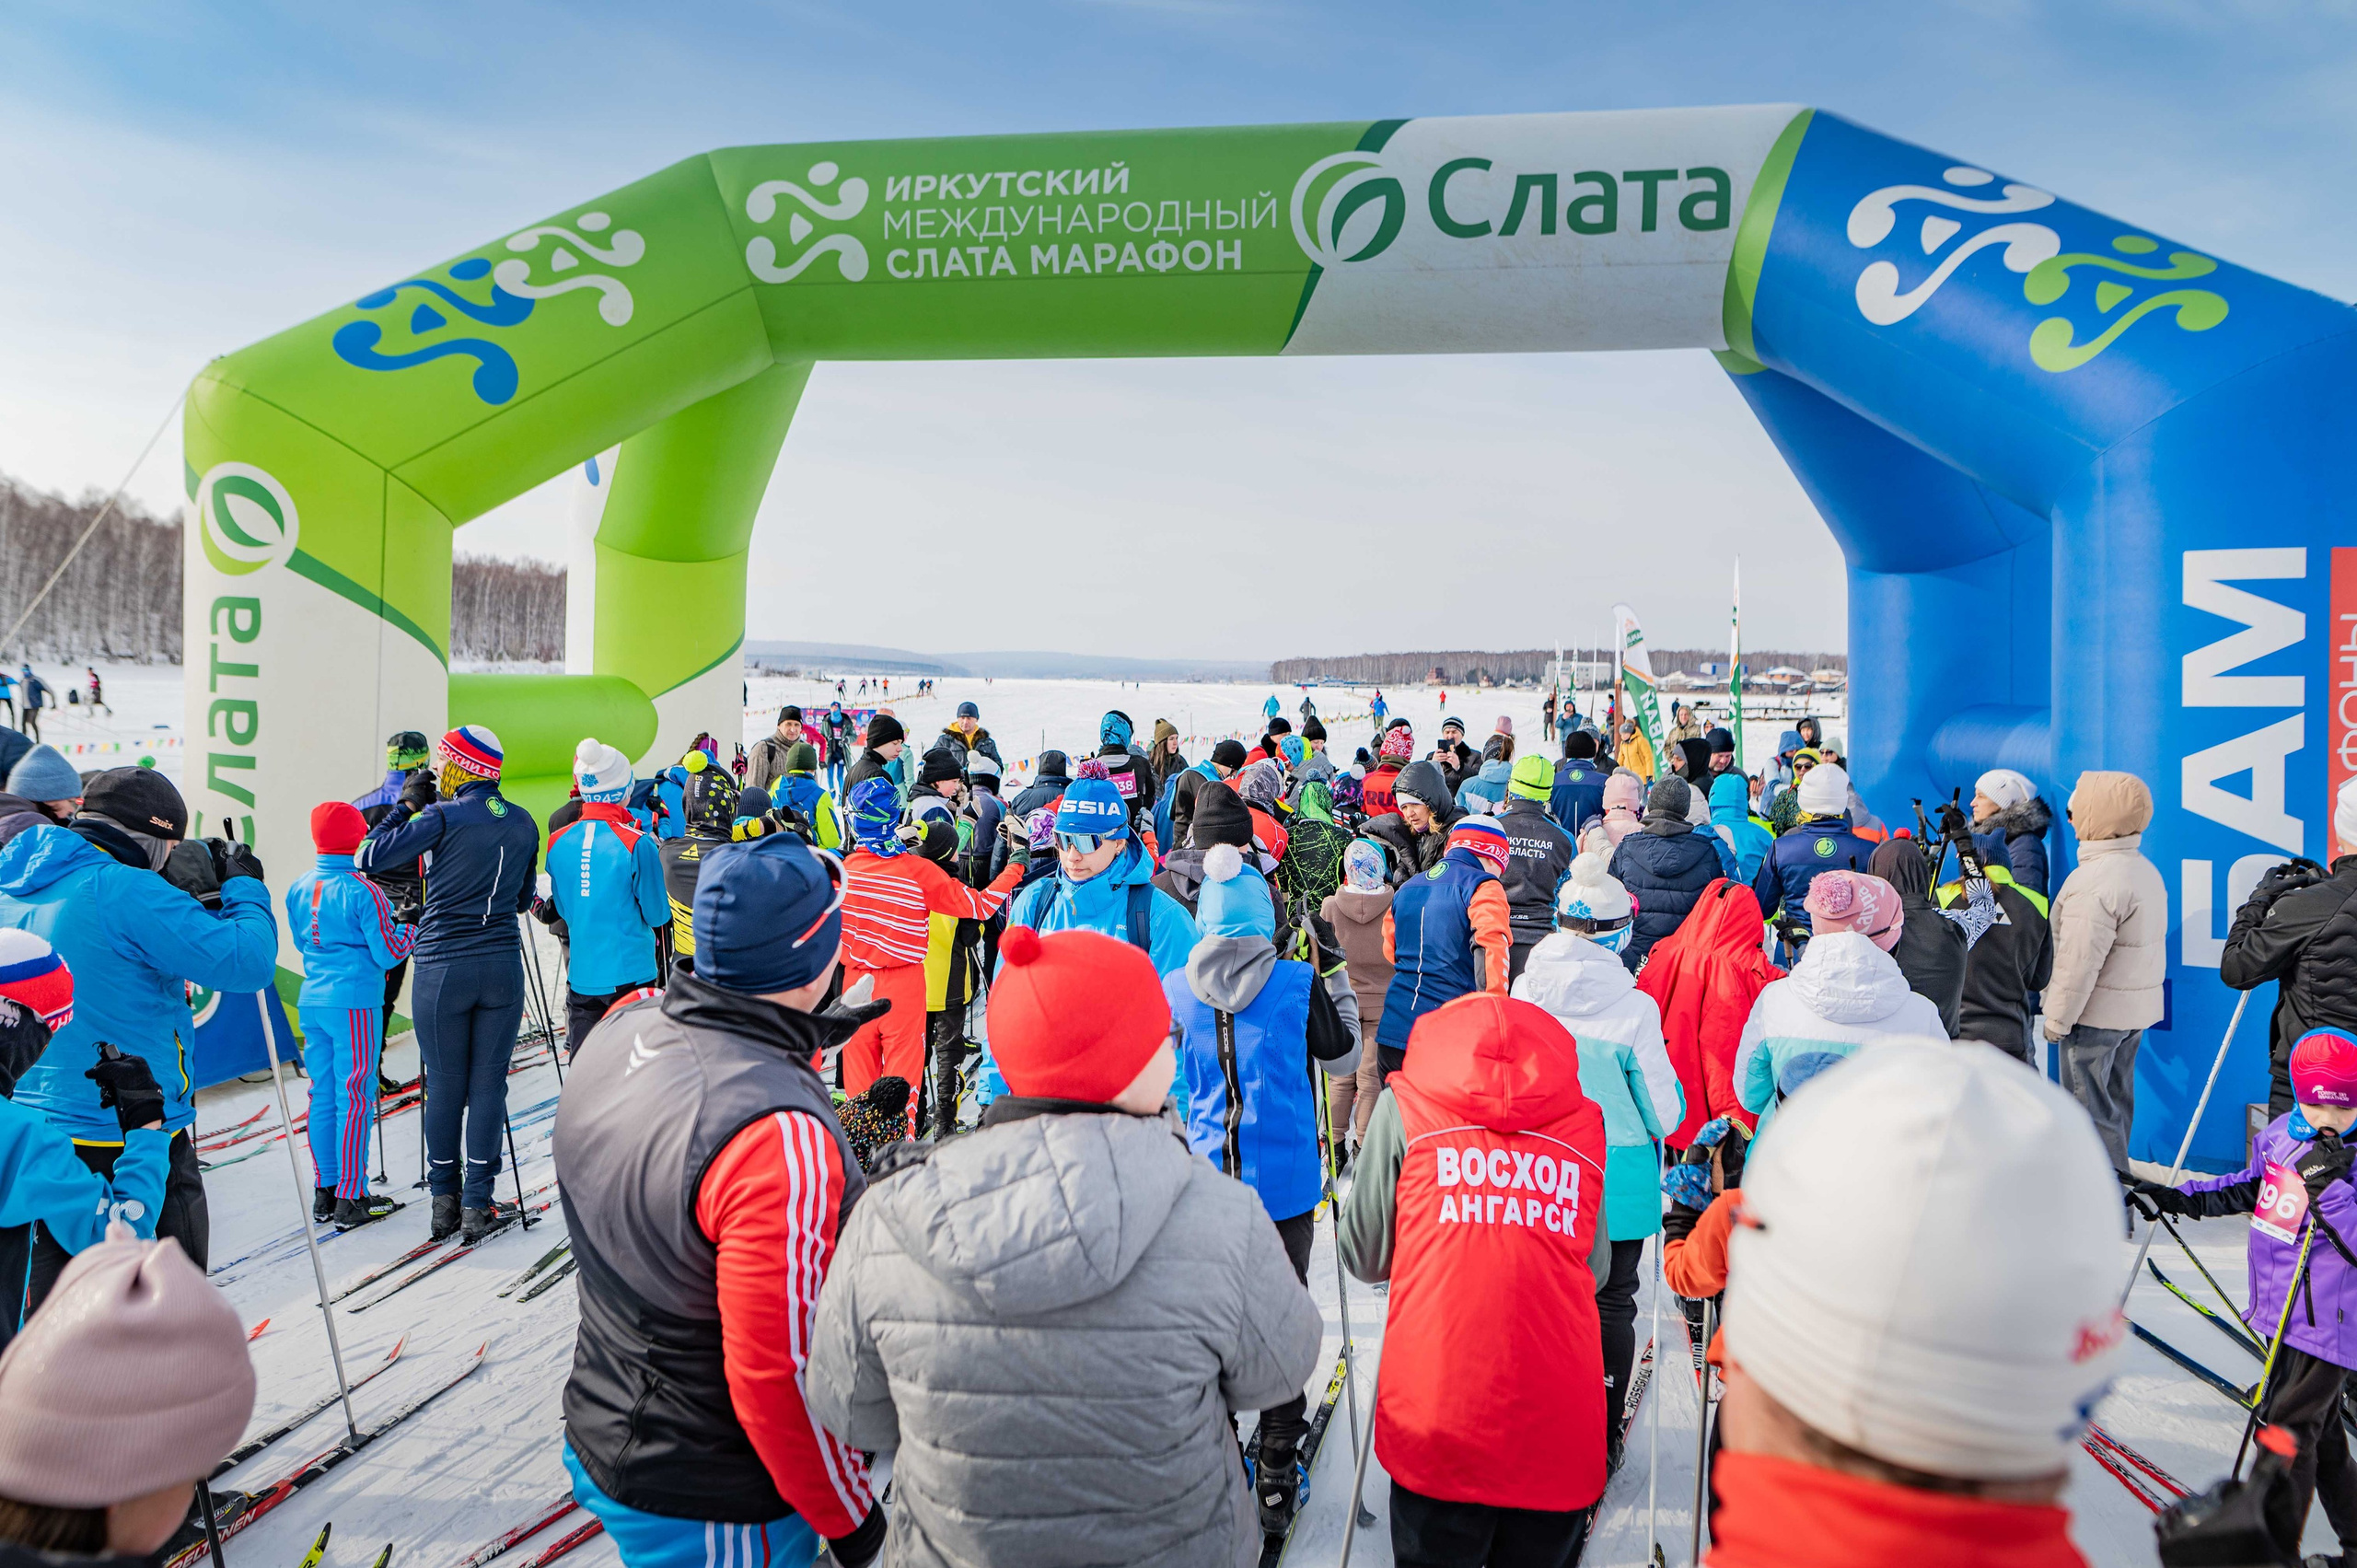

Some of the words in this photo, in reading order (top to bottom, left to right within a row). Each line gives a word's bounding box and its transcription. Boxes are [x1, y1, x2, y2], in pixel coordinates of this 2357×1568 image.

[885, 161, 1130, 202] ИРКУТСКИЙ
[1428, 157, 1731, 238] Слата
[884, 191, 1278, 242] МЕЖДУНАРОДНЫЙ
[886, 245, 1017, 279] СЛАТА
[1030, 239, 1242, 274] МАРАФОН
[1366, 791, 1398, 807] RU
[149, 816, 173, 830] Swix
[581, 850, 591, 897] RUSSIA
[1508, 847, 1546, 859] БЛАСТЬ
[1436, 1147, 1580, 1209] ВОСХОД
[1438, 1194, 1577, 1238] АНГАРСК
[1630, 1368, 1653, 1410] ROSSIGNOL
[171, 1508, 258, 1568] ELTNEN
